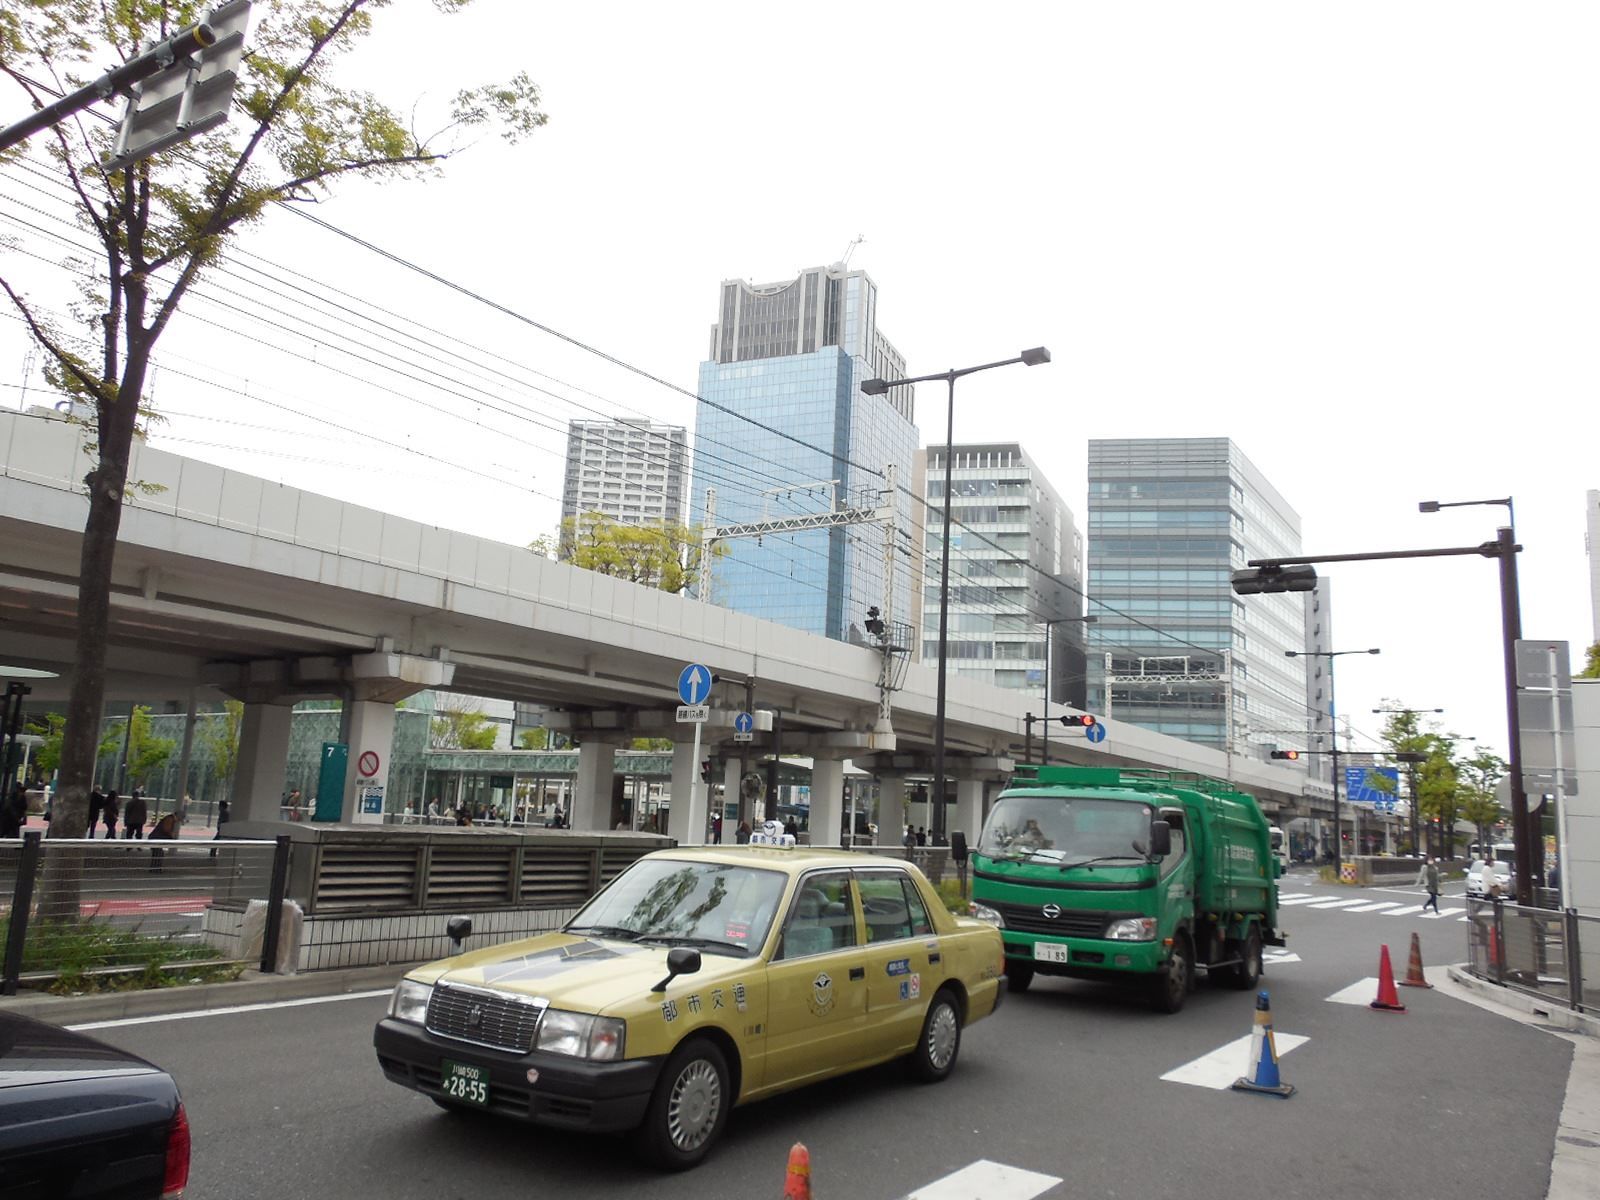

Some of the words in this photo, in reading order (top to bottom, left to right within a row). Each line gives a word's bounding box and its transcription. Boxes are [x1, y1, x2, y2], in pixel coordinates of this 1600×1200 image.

[327, 747, 335, 757] 7
[662, 983, 746, 1022] 都市交通
[466, 1067, 479, 1080] 500
